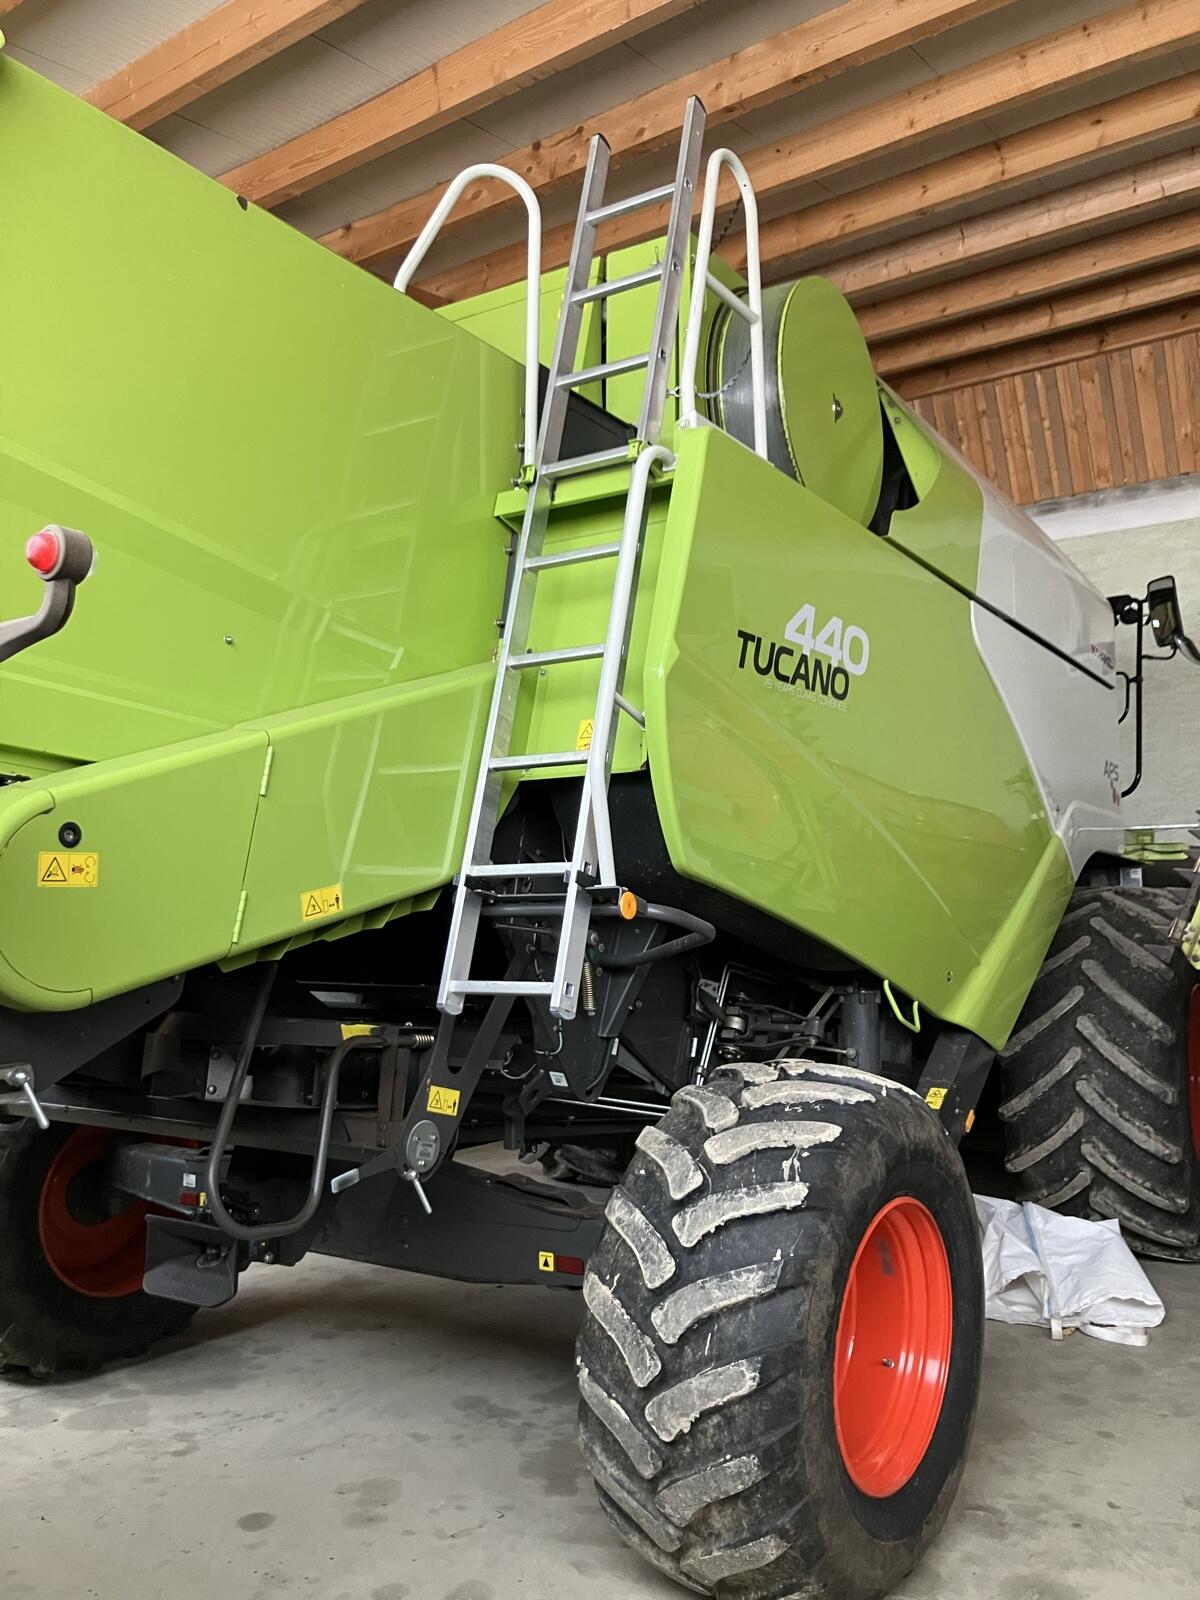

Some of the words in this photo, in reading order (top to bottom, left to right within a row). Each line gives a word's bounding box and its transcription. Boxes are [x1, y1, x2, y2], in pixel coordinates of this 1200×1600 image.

[737, 629, 850, 701] TUCANO
[784, 603, 870, 676] 440
[1103, 759, 1119, 782] APS
